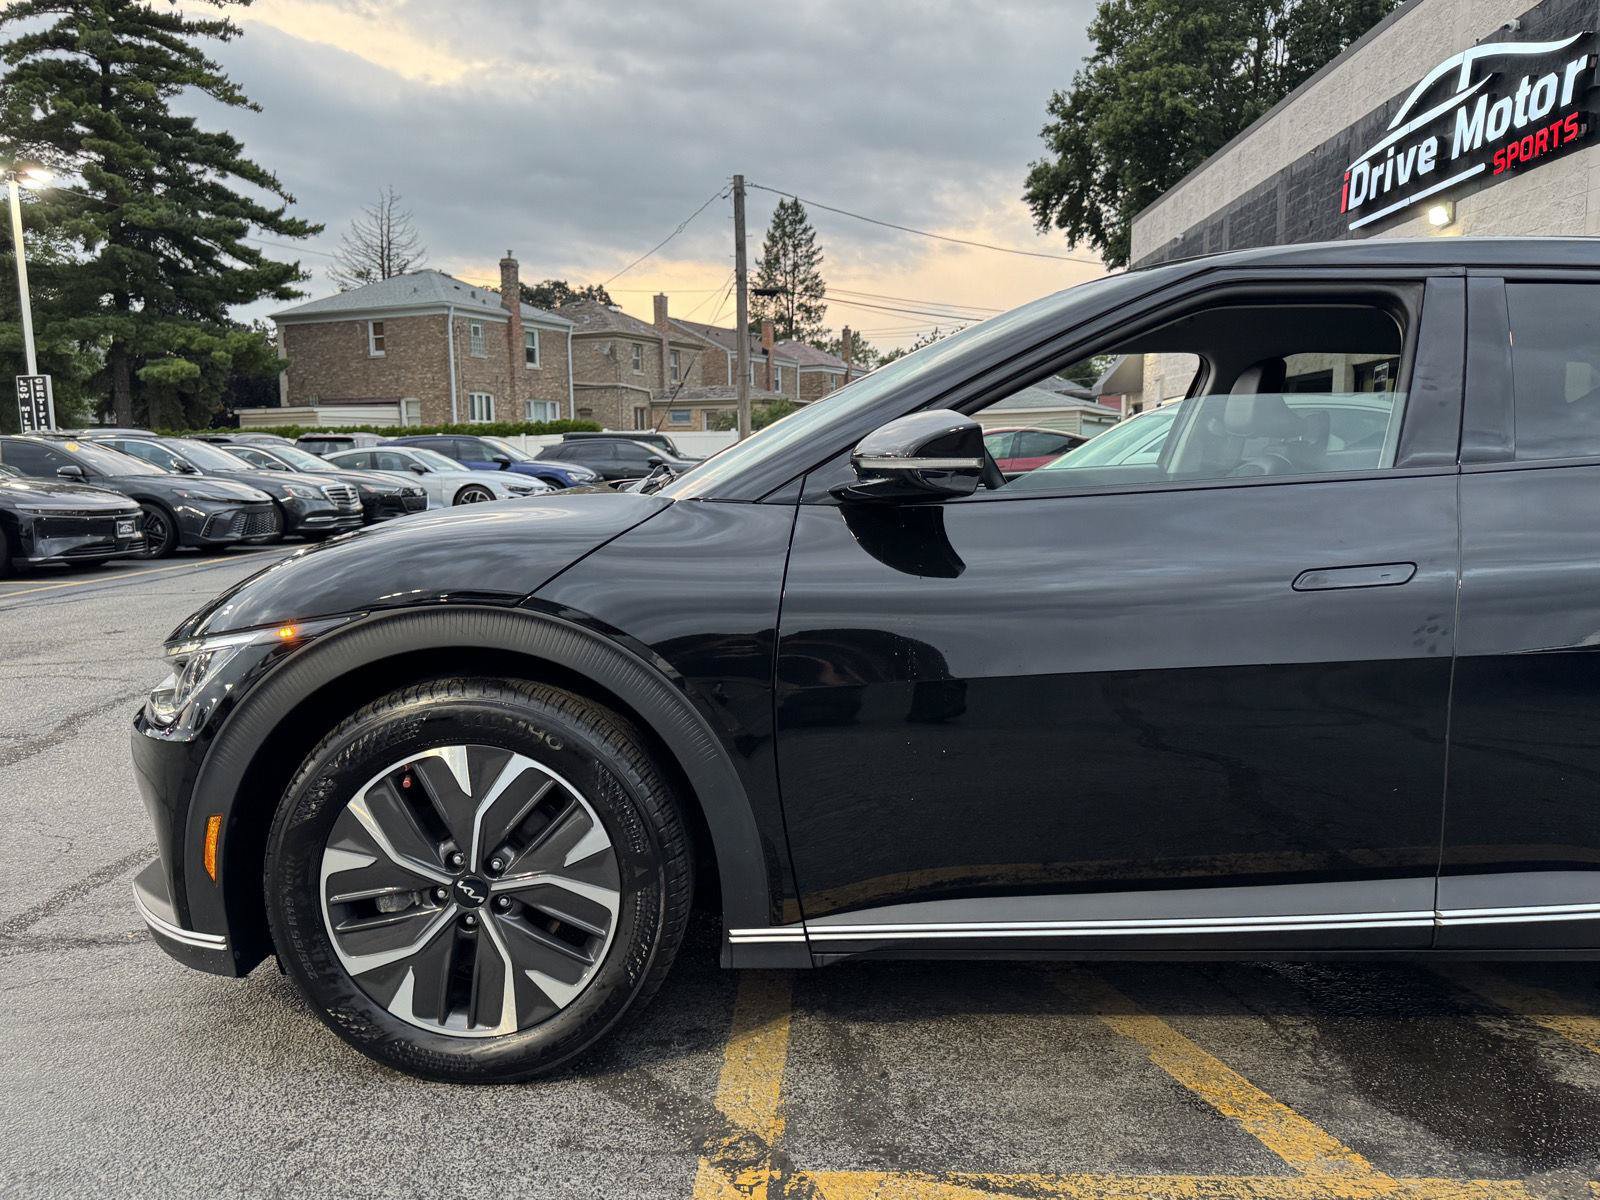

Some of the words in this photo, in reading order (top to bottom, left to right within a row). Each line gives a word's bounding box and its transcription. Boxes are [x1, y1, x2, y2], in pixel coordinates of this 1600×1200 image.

[1340, 136, 1439, 214] iDrive
[1450, 54, 1589, 161] Motor
[1492, 111, 1580, 176] SPORTS
[19, 380, 29, 399] LOW
